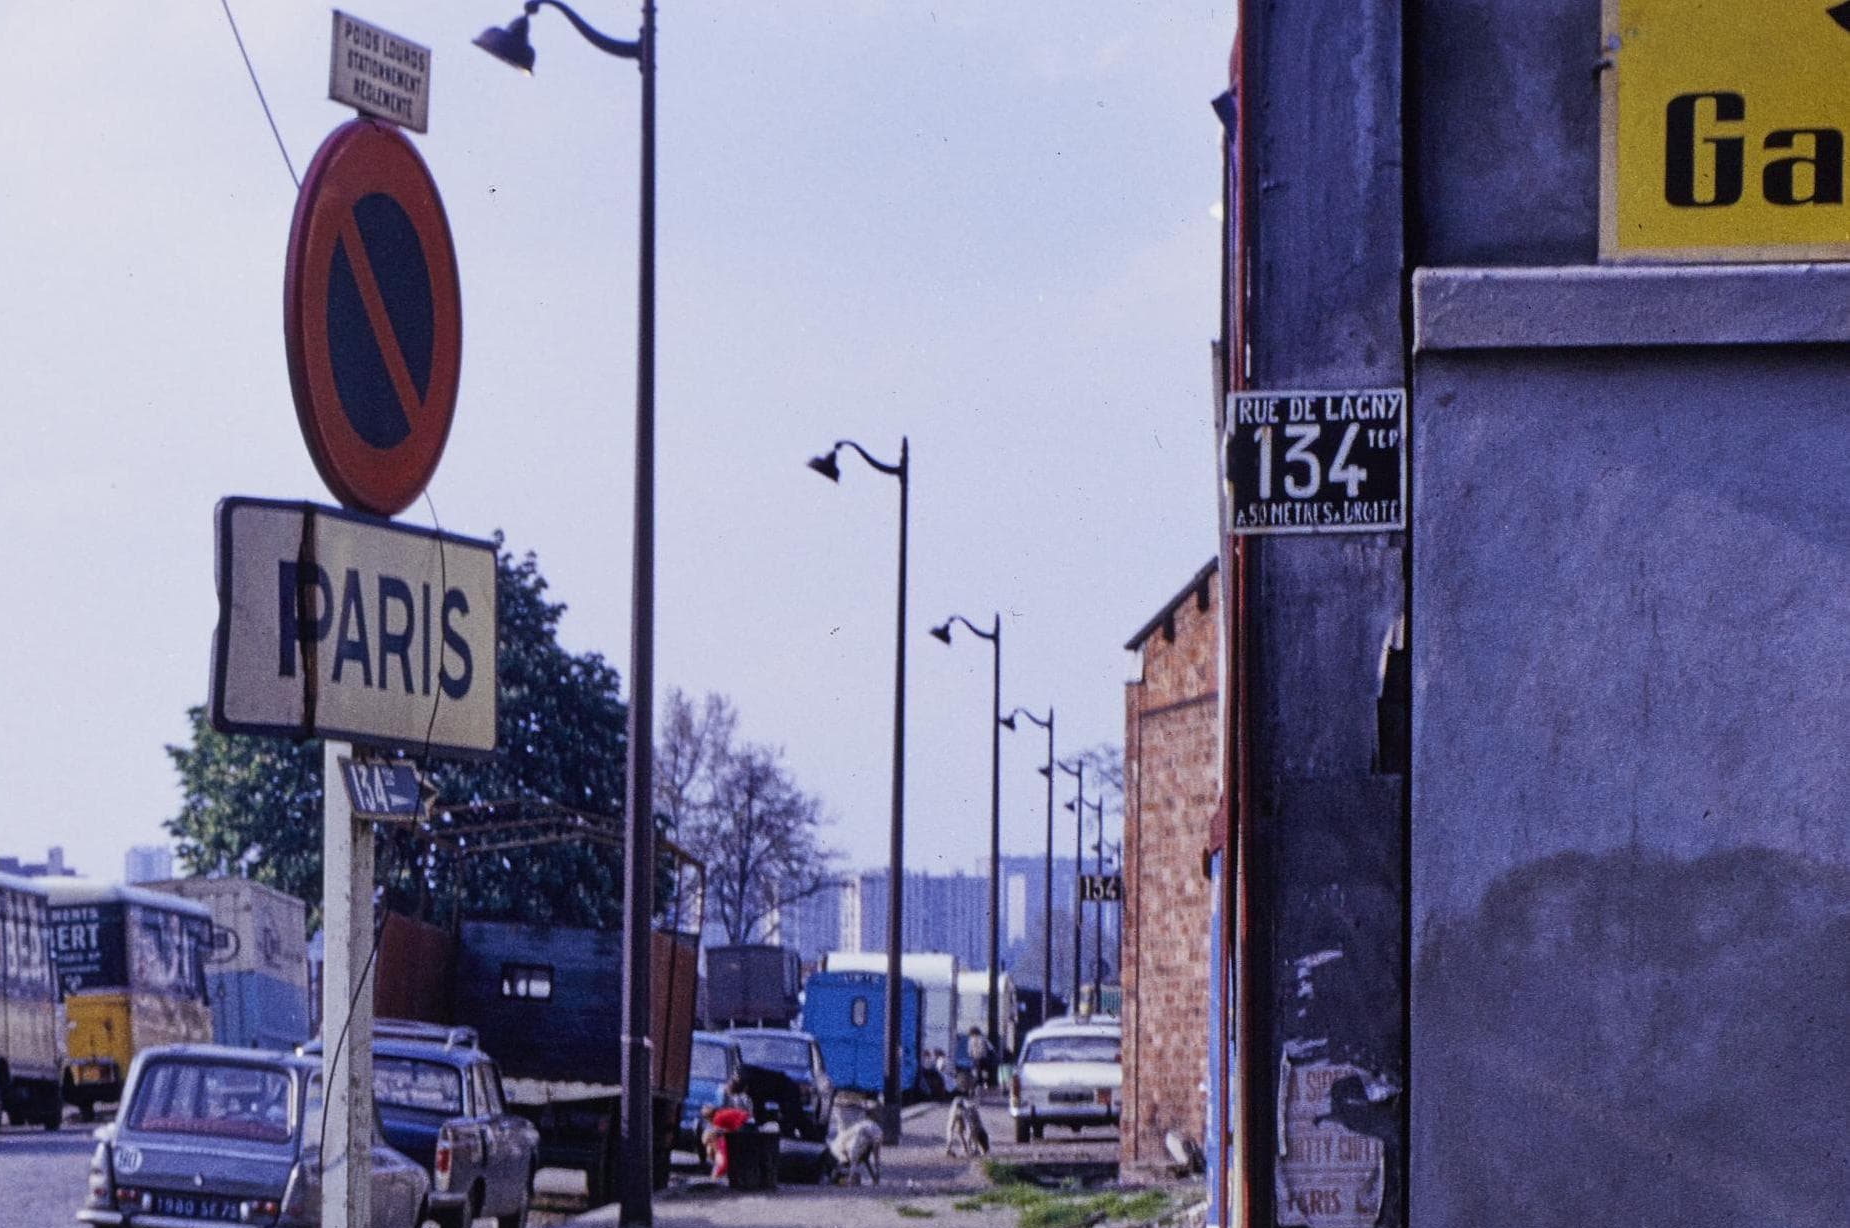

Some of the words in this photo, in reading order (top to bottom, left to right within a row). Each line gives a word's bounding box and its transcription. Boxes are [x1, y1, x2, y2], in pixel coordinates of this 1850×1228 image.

[1664, 91, 1844, 207] Ga
[1239, 399, 1279, 424] RUE
[1290, 397, 1316, 421] DE
[1325, 394, 1400, 420] LAGNY
[1254, 422, 1367, 500] 134
[278, 559, 474, 700] PARIS
